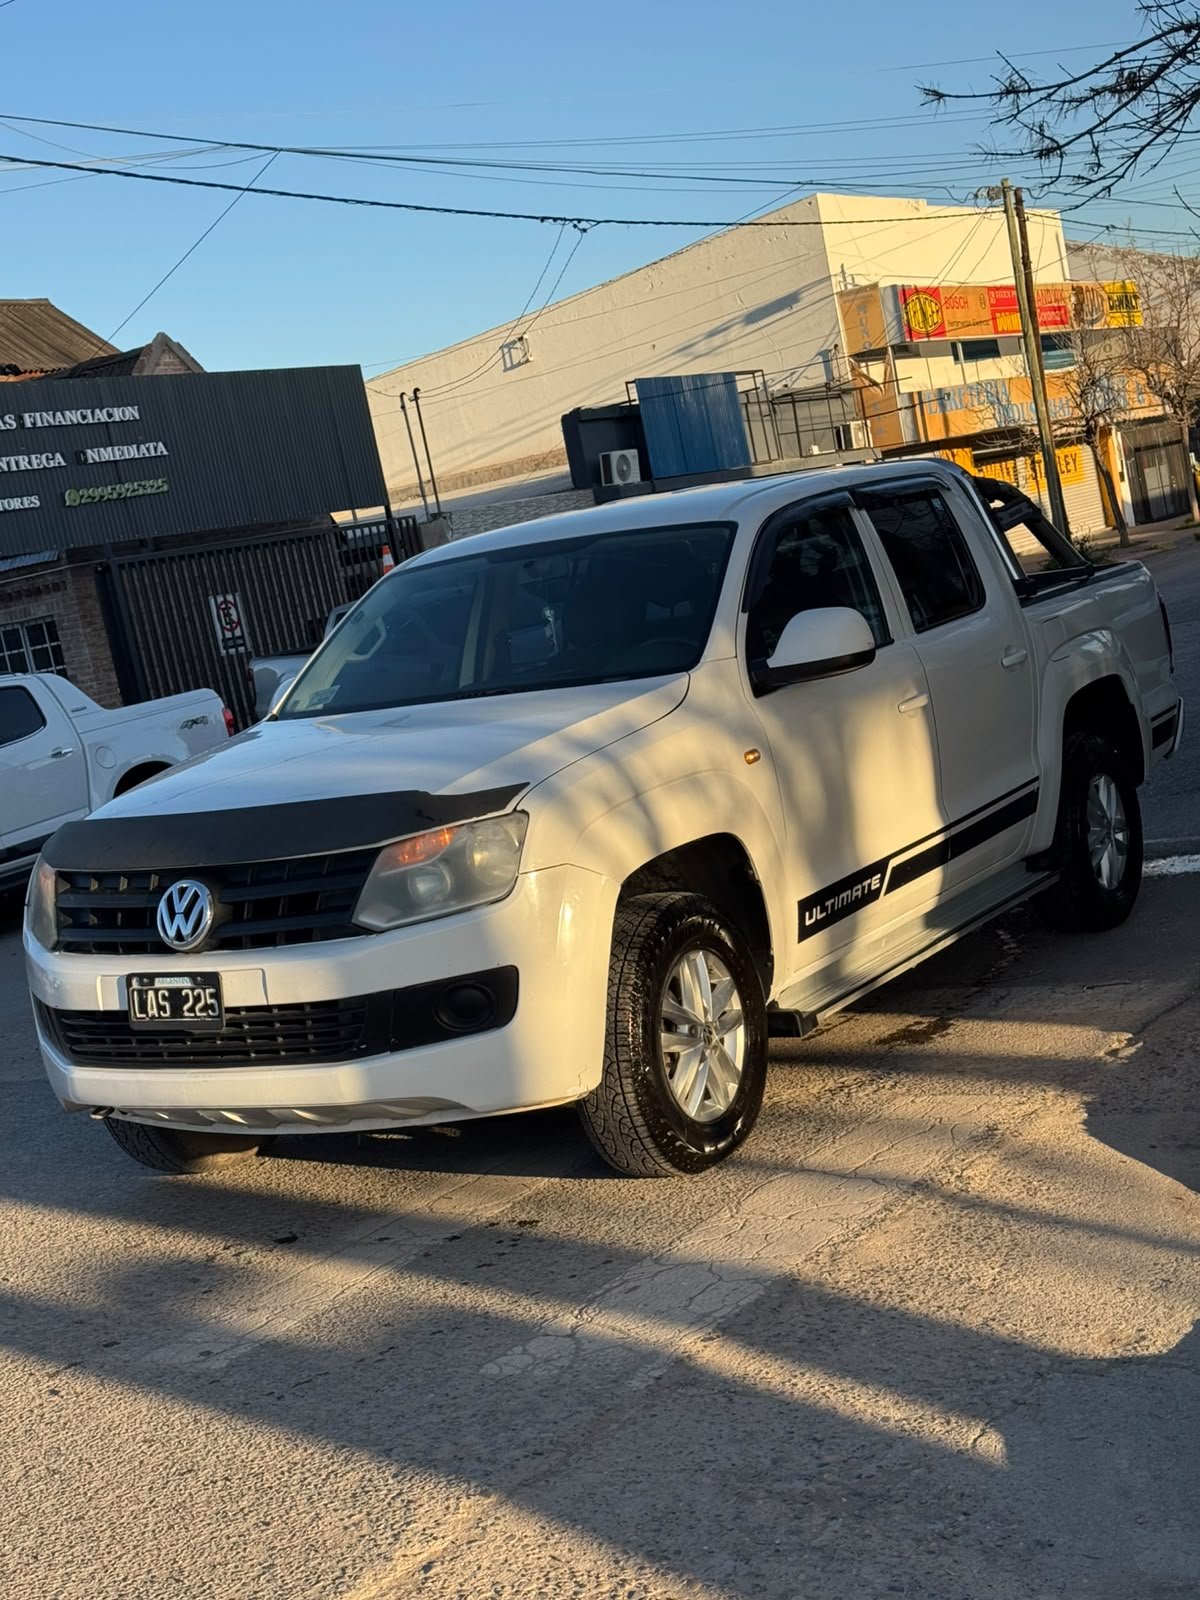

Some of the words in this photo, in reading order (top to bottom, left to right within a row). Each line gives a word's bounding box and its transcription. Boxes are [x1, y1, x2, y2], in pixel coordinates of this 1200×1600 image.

[943, 296, 969, 310] BOSCH
[1036, 289, 1065, 305] ANDVIK
[22, 406, 140, 428] FINANCIACION
[79, 442, 169, 465] NMEDIATA
[1030, 453, 1077, 480] STLEY
[804, 873, 882, 927] ULTIMATE
[133, 989, 170, 1019] LAS
[181, 987, 219, 1017] 225
